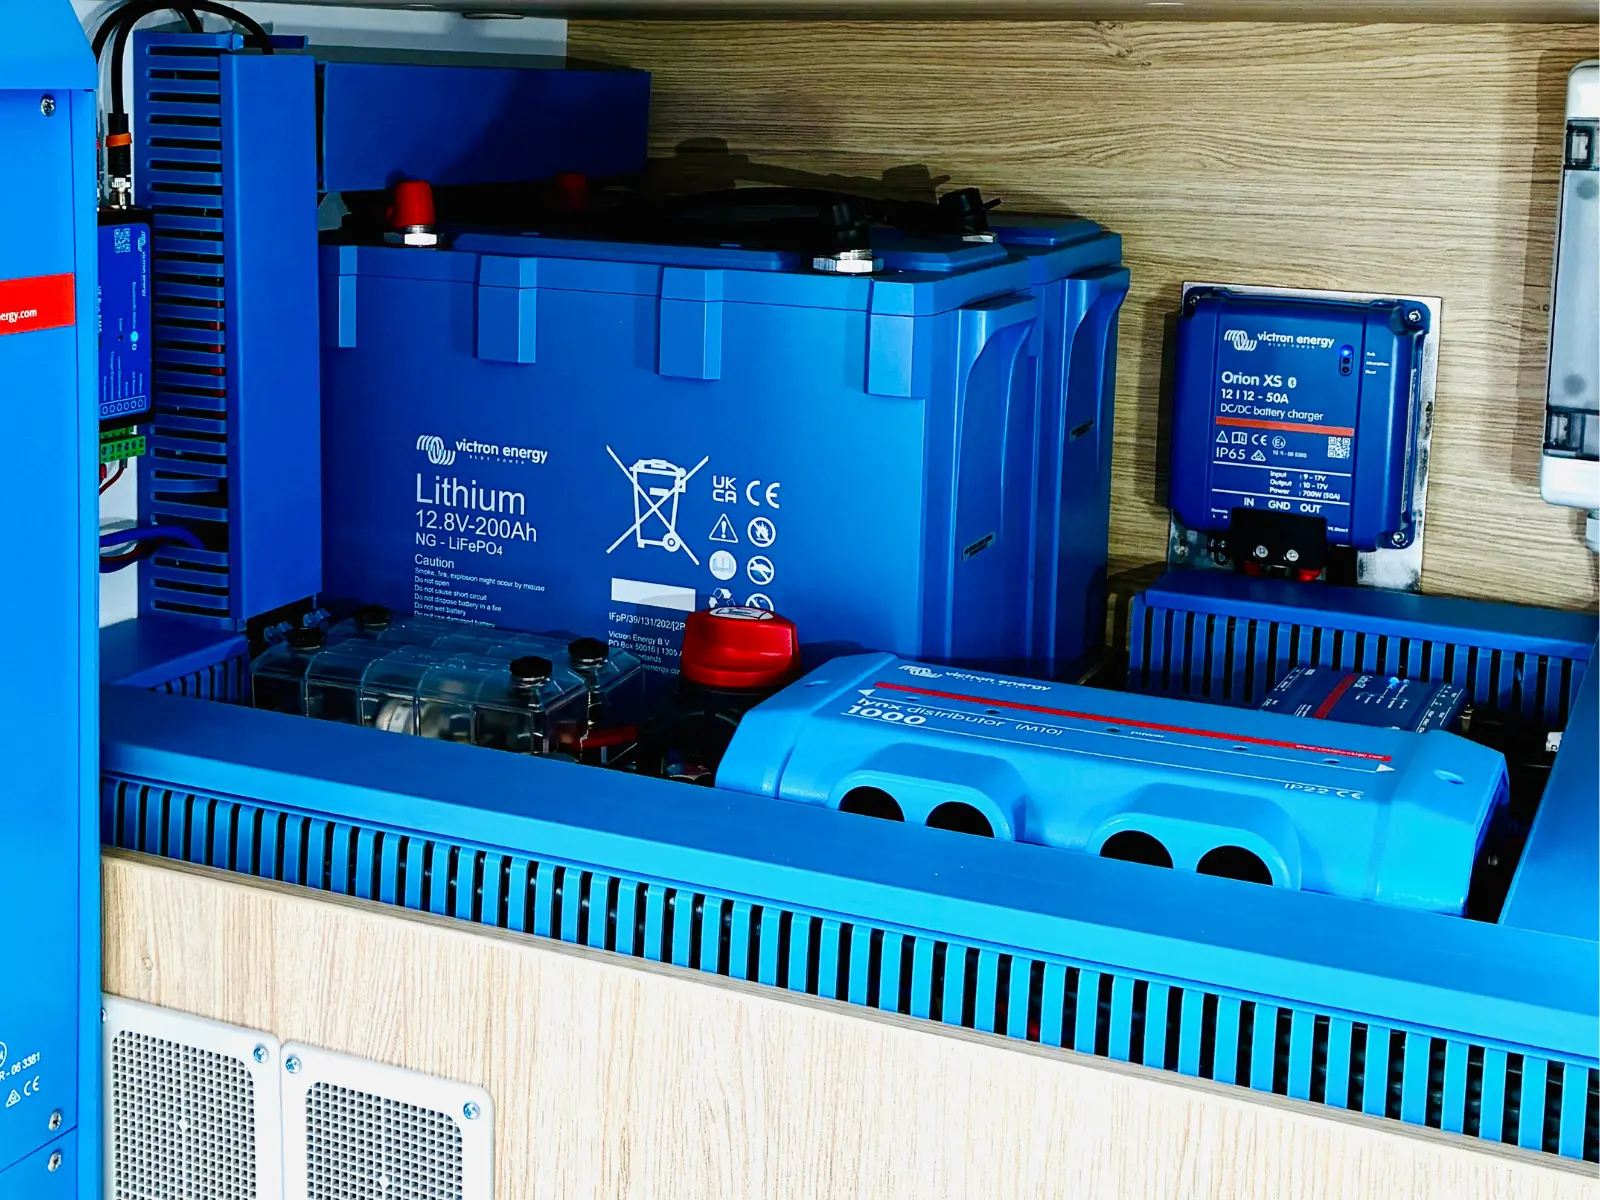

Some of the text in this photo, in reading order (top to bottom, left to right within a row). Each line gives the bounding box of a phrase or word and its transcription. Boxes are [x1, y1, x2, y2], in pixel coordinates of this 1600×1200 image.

[1257, 331, 1293, 343] victron
[1296, 336, 1335, 348] energy
[1221, 371, 1282, 387] Orion XS
[1221, 388, 1233, 399] 12
[1242, 390, 1254, 401] 12
[1266, 392, 1289, 404] 50A
[1220, 403, 1324, 422] DC/DC battery charger
[455, 438, 548, 464] victron energy
[1215, 447, 1246, 460] IP65
[1269, 470, 1287, 478] Input
[712, 475, 737, 490] UK
[1269, 479, 1292, 487] Output
[416, 473, 525, 515] Lithium
[712, 489, 737, 504] CA
[745, 480, 780, 509] CE
[1269, 487, 1290, 495] Power
[1302, 490, 1322, 498] 700W
[1323, 492, 1340, 500] (50A)
[1244, 497, 1322, 514] IN GND OUT
[416, 509, 537, 542] 12.8V-200Ah
[415, 532, 436, 547] NG
[449, 536, 503, 555] LiFePO4
[414, 553, 455, 569] Caution
[414, 567, 437, 577] Smoke,
[450, 573, 478, 582] explosion
[479, 576, 496, 586] might
[496, 580, 513, 588] occur
[514, 581, 523, 590] by
[424, 577, 434, 585] not
[424, 586, 434, 594] not
[435, 588, 453, 596] cause
[453, 590, 469, 598] short
[469, 592, 487, 601] circuit
[414, 601, 423, 609] Do
[423, 603, 434, 611] not
[445, 606, 466, 617] battery
[424, 594, 434, 602] not
[434, 596, 457, 606] dispose
[458, 599, 479, 610] battery
[491, 604, 502, 612] fire
[608, 630, 631, 640] Victron
[632, 633, 656, 645] Energy
[945, 671, 995, 683] victron
[847, 705, 927, 725] 1000
[857, 697, 1063, 736] lynx distributor (M10)
[1284, 783, 1329, 795] IP22
